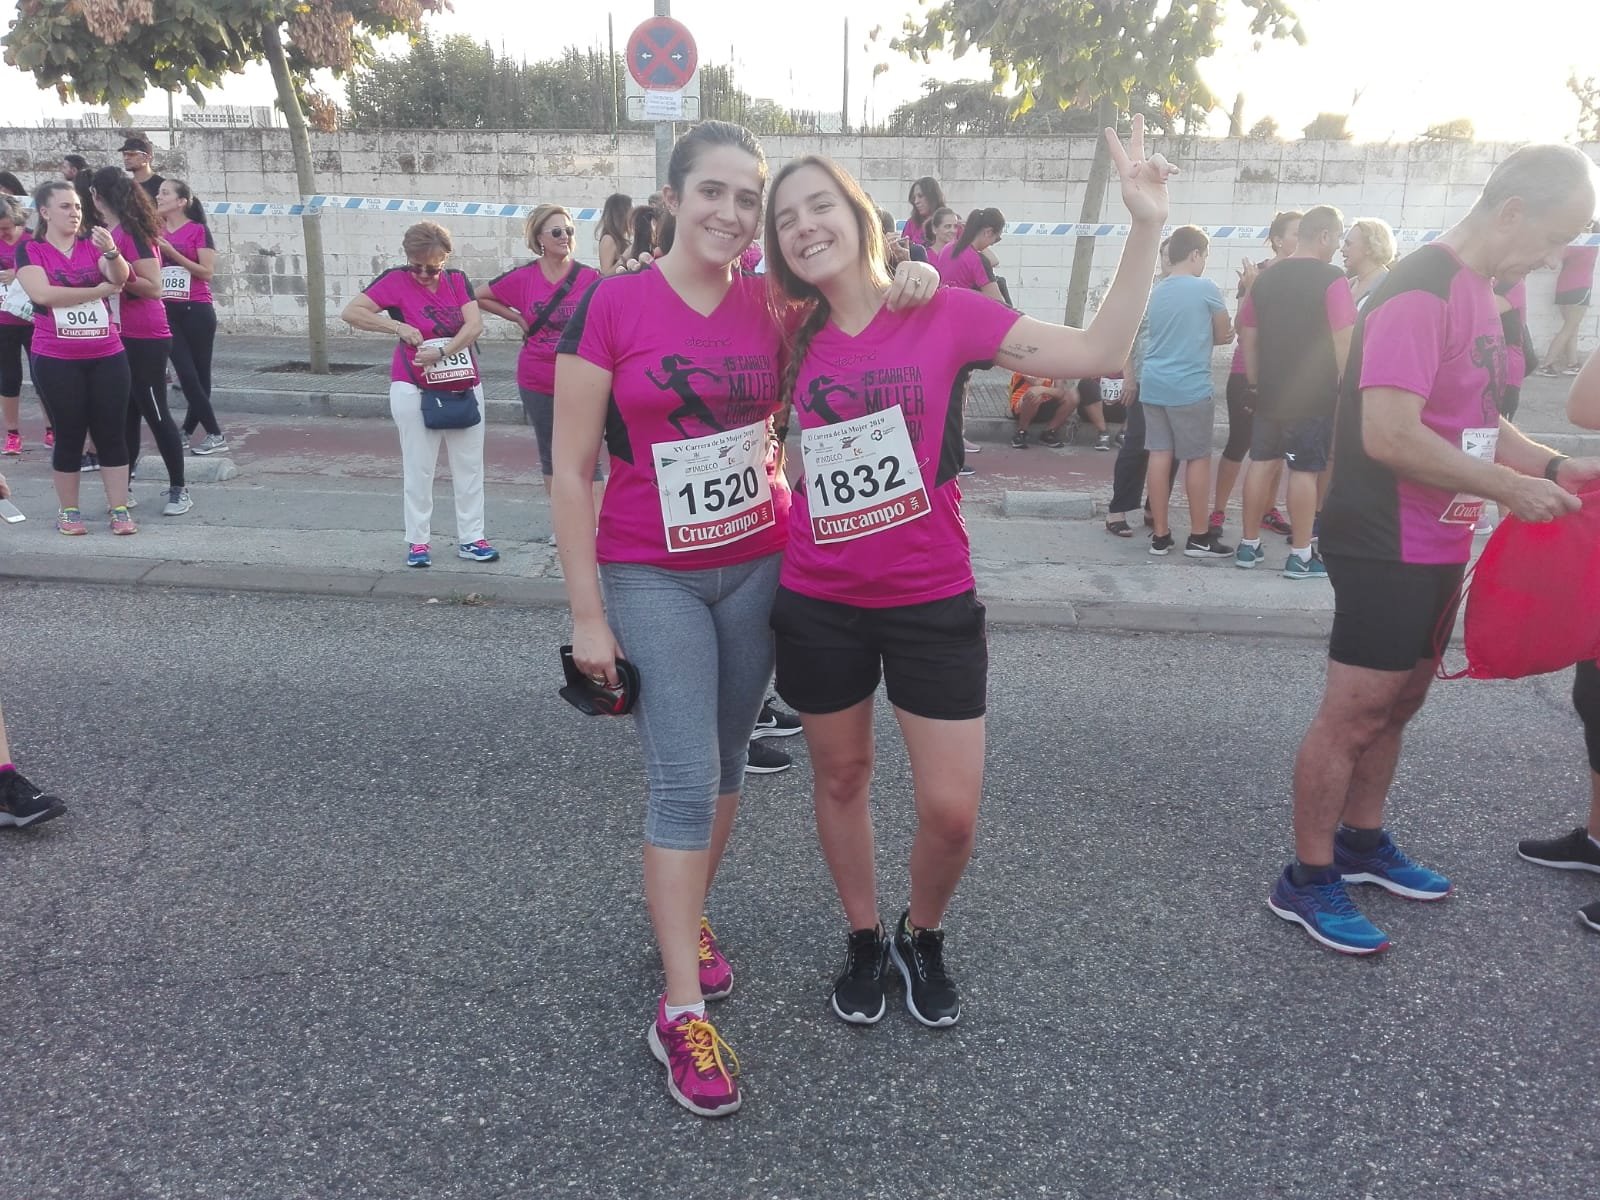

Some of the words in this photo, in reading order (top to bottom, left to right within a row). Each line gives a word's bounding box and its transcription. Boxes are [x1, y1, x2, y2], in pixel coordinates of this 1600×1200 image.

[67, 311, 98, 325] 904
[61, 328, 101, 337] Cruzcampo
[430, 369, 469, 380] Cruzcampo
[878, 366, 923, 385] CARRERA
[728, 372, 777, 402] MUJER
[833, 428, 842, 438] de
[842, 427, 848, 435] la
[848, 422, 869, 435] Mujer
[870, 417, 885, 428] 2019
[673, 446, 684, 454] XV
[685, 442, 711, 452] Carrera
[726, 433, 742, 443] Mujer
[678, 466, 759, 515] 1520
[814, 455, 906, 507] 1832
[678, 511, 759, 543] Cruzcampo
[818, 502, 906, 535] Cruzcampo
